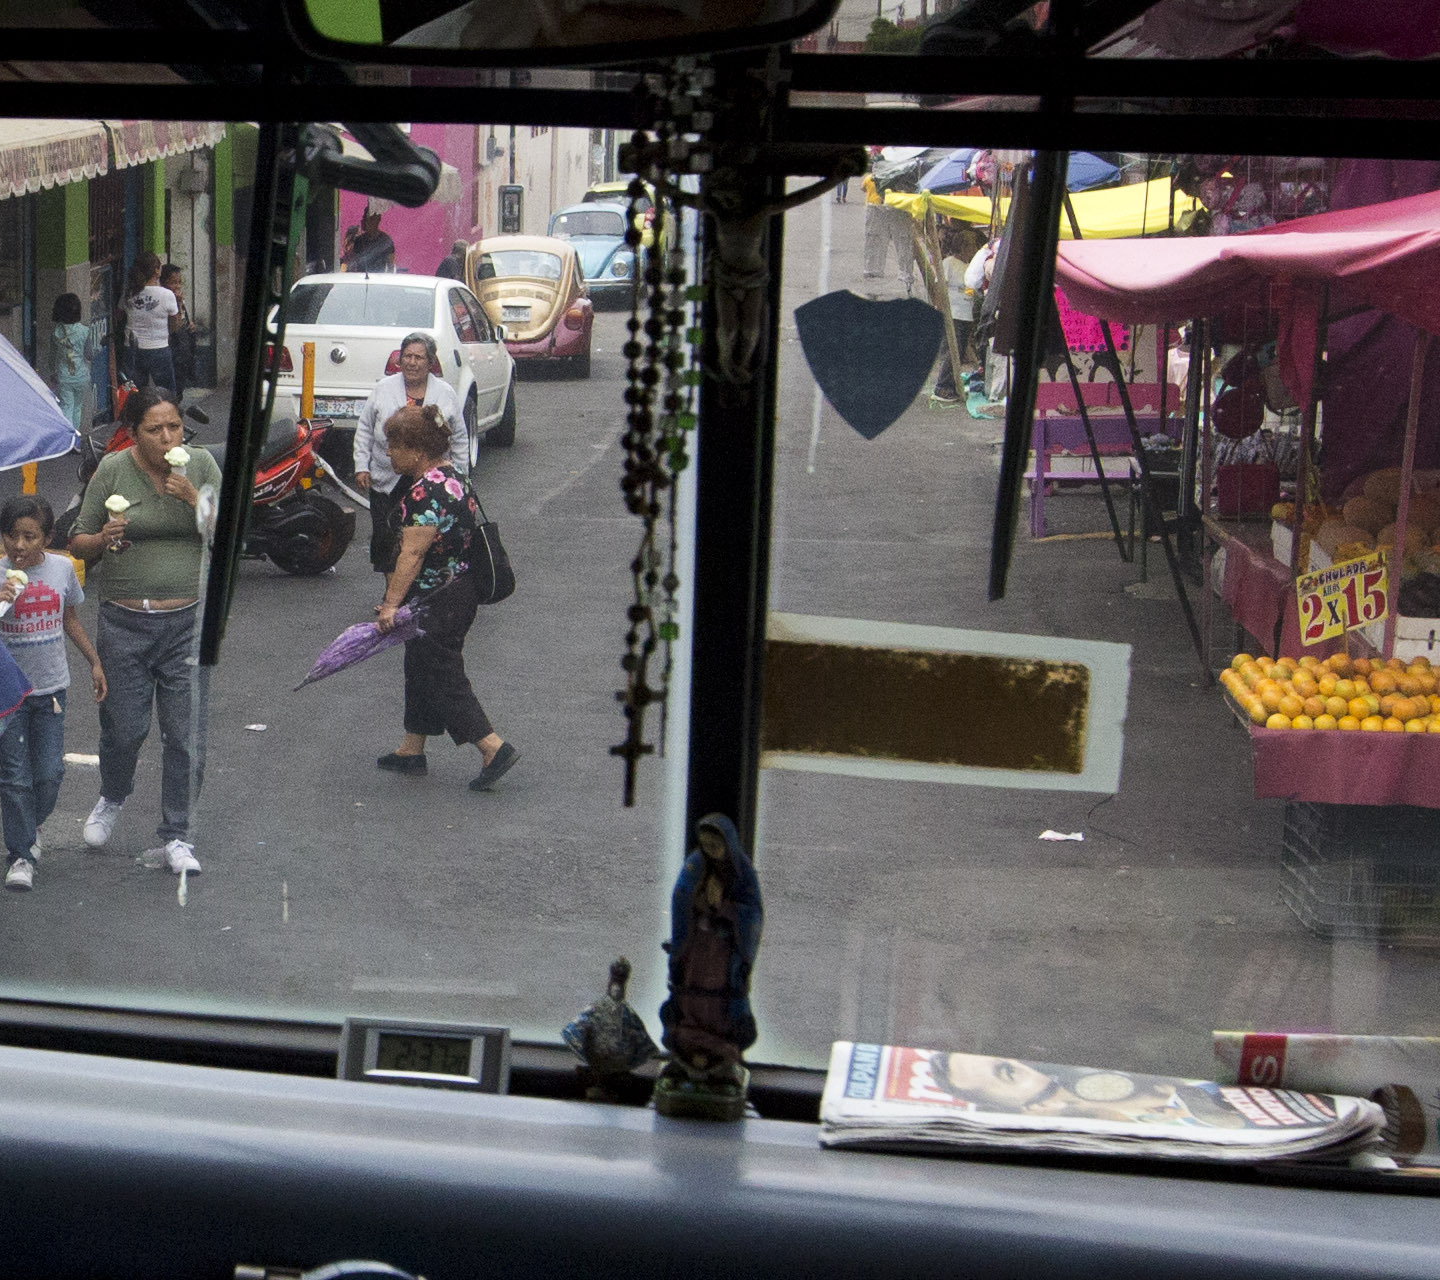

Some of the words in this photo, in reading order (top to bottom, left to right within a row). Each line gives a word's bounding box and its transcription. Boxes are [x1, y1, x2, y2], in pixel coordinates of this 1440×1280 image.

[1318, 561, 1367, 585] CHULADA
[1302, 593, 1325, 641] 2
[1342, 570, 1386, 629] 15
